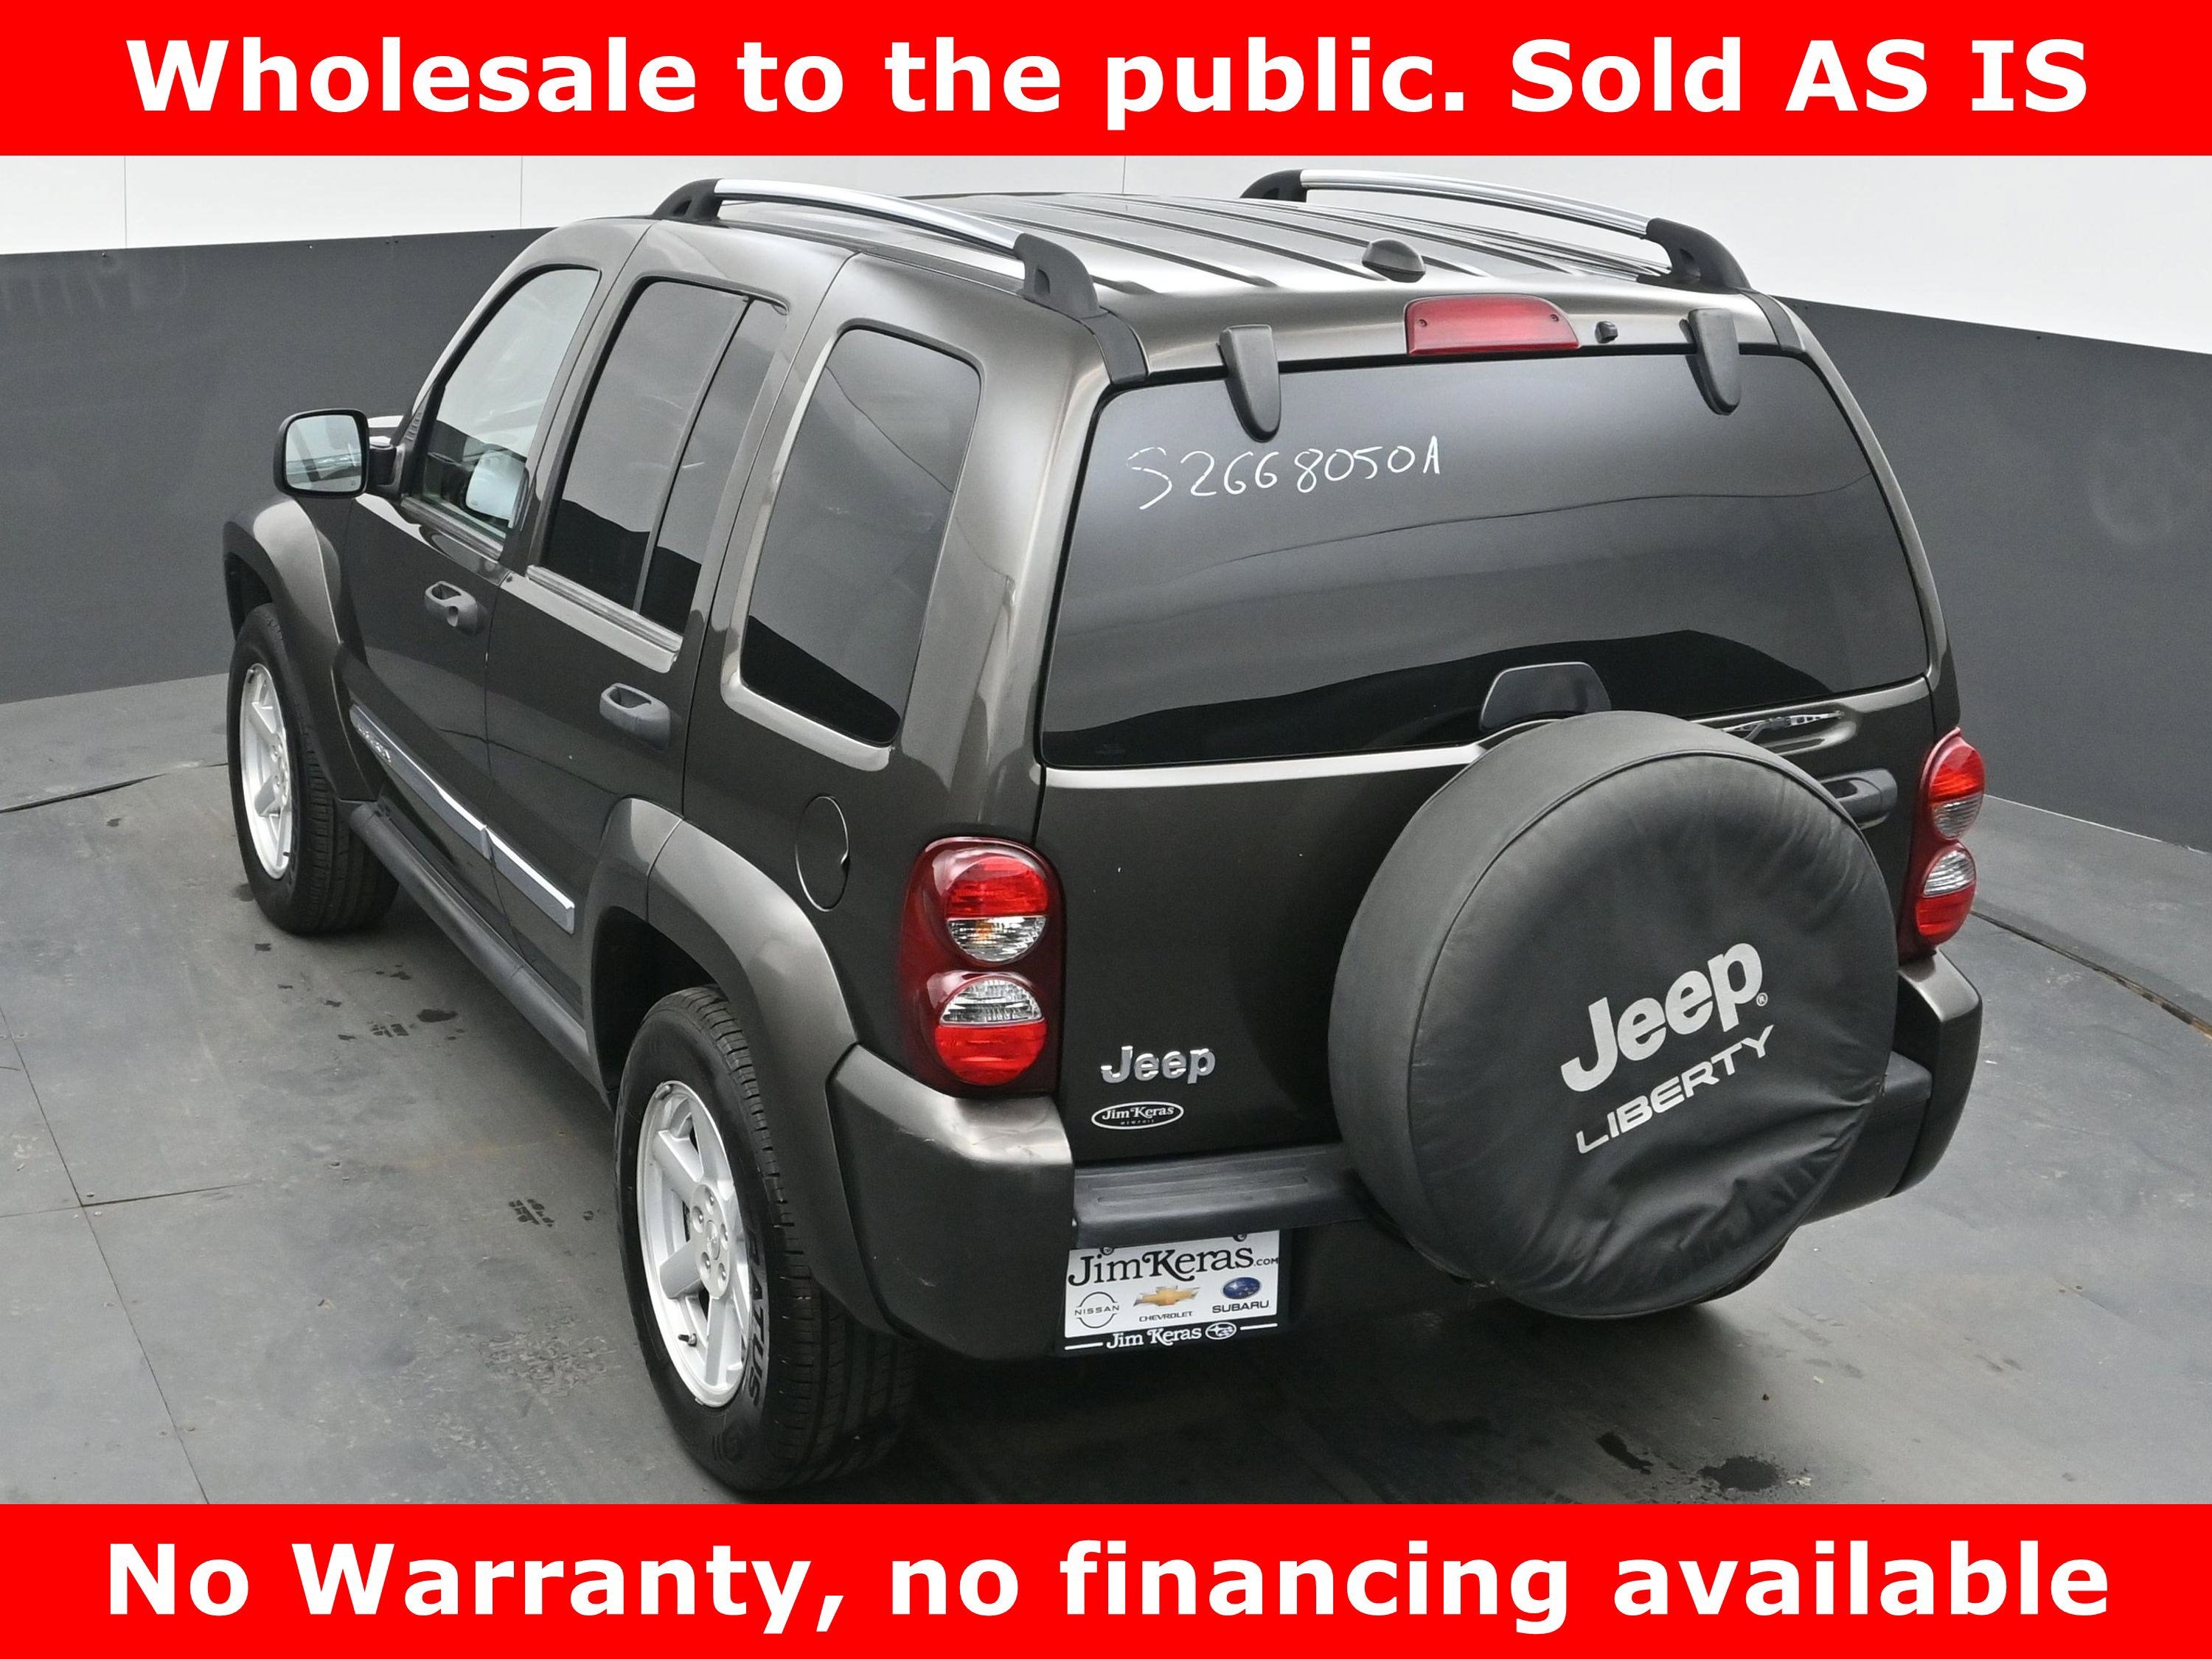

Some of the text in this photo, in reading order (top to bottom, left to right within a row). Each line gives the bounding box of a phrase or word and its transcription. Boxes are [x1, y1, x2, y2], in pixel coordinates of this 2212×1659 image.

[1560, 942, 1764, 1093] Jeep
[1100, 1045, 1216, 1085] Jeep
[1575, 1024, 1775, 1155] LIBERTY
[1074, 1304, 1120, 1316] NISSAN
[1138, 1311, 1193, 1322] CHEVROLET
[1211, 1300, 1270, 1314] SUBARU
[1106, 1327, 1203, 1349] Jim Keras
